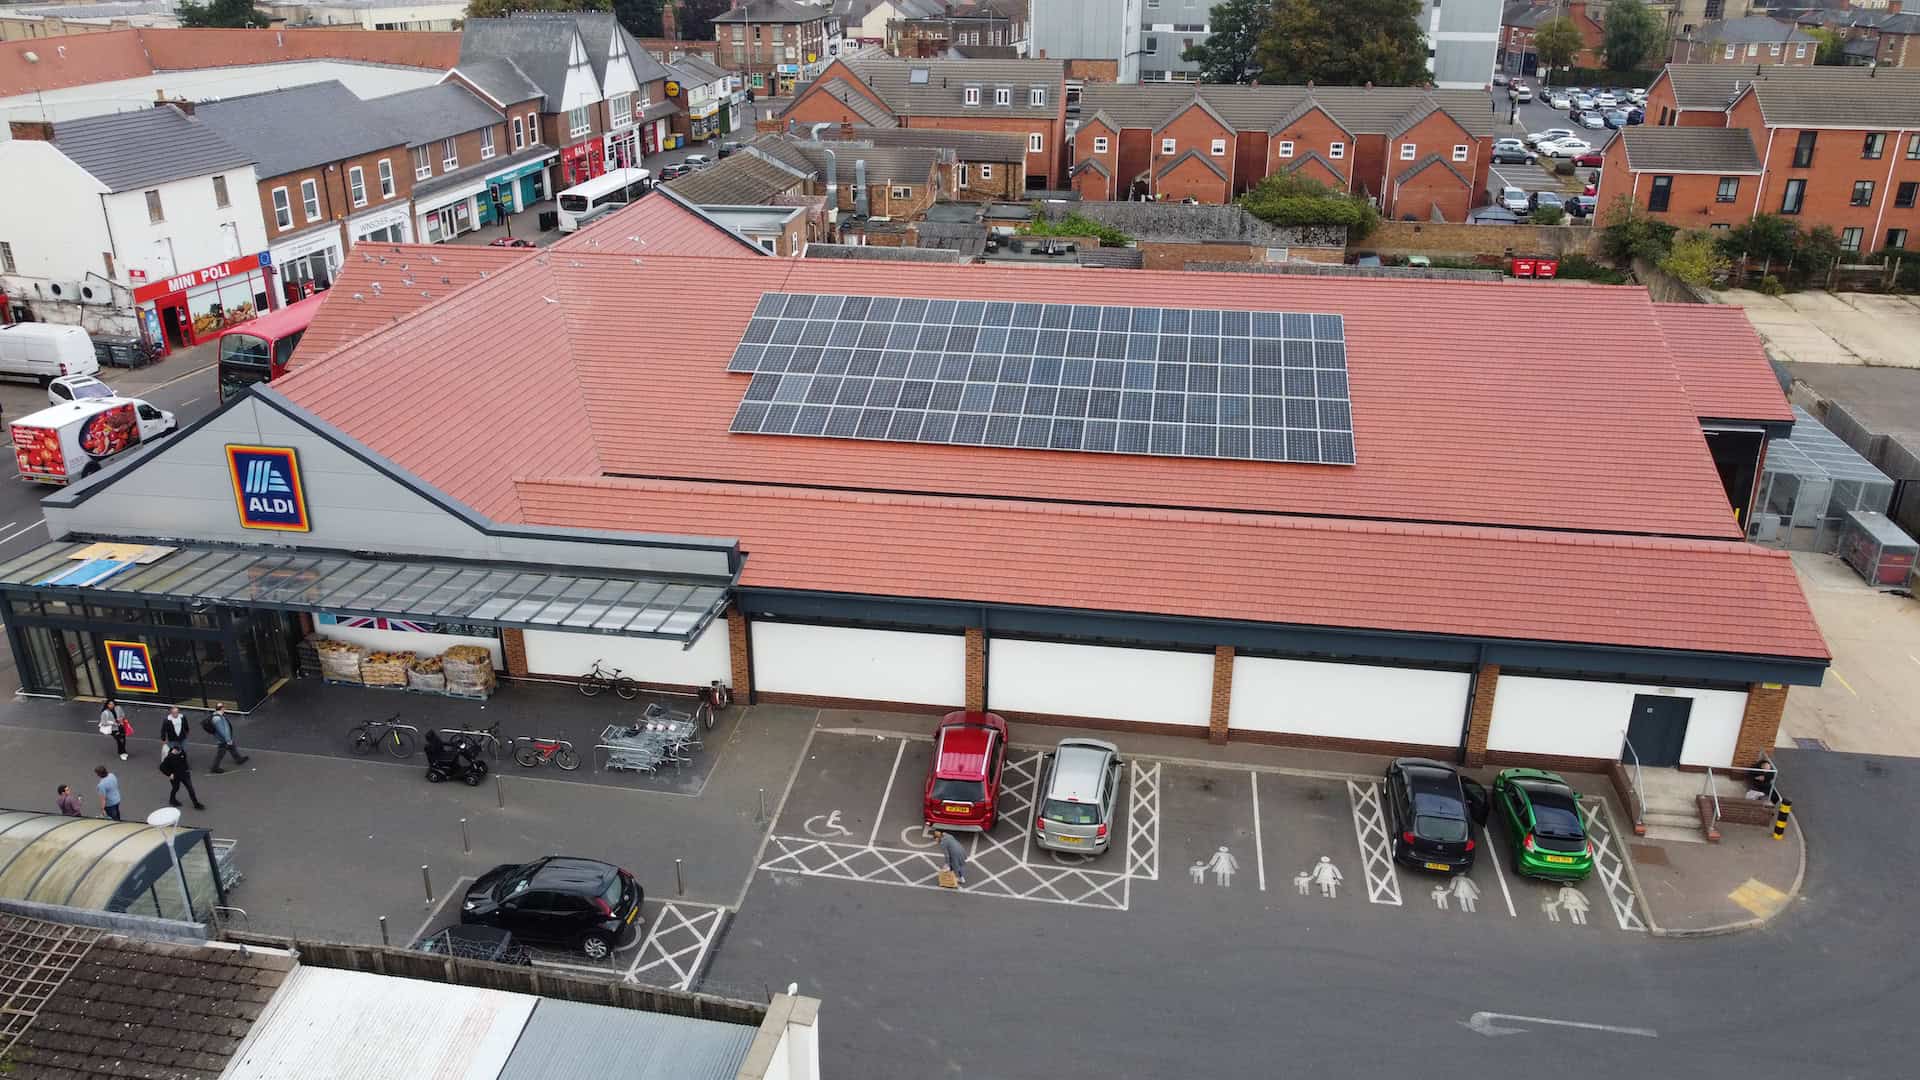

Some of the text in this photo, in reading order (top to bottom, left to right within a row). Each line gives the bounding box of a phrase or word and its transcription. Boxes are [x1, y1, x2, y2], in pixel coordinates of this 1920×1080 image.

[167, 263, 231, 292] MINI POLI
[249, 497, 295, 514] ALDI
[120, 671, 149, 683] ALDI
